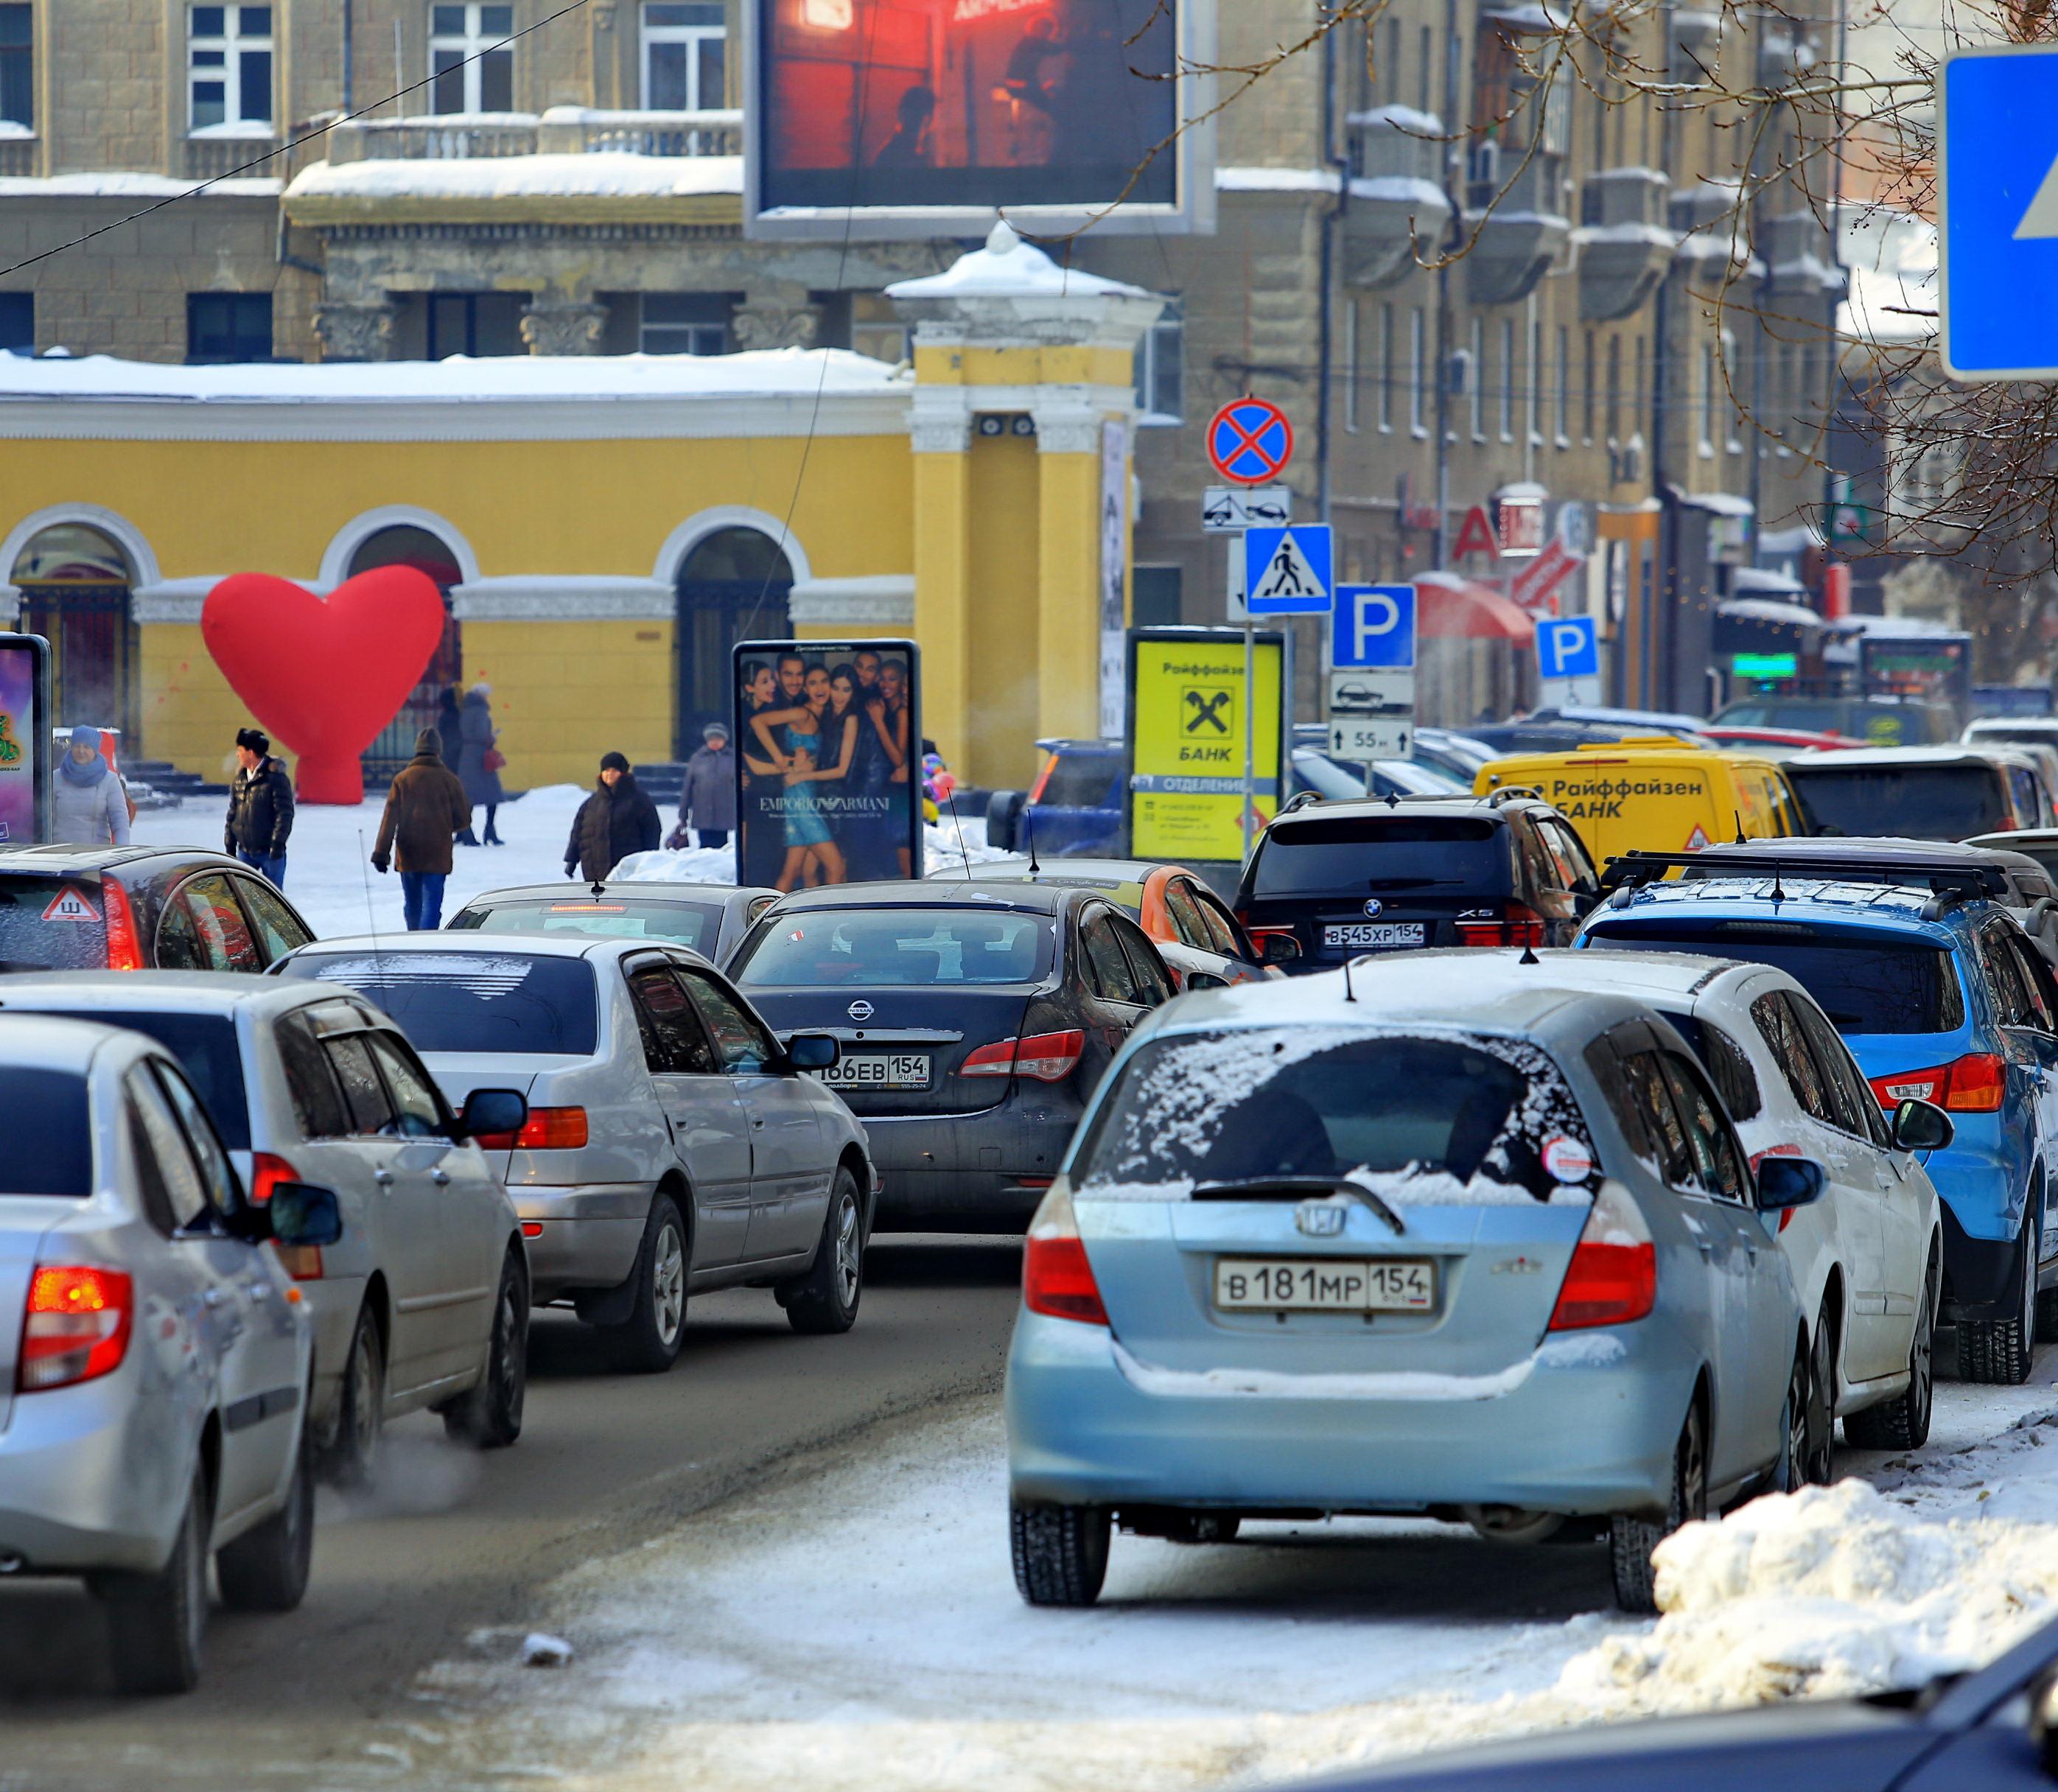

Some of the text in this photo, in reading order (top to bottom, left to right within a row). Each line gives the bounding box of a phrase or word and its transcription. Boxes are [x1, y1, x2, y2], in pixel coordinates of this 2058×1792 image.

[1354, 594, 1399, 660] P
[1553, 625, 1586, 672] P
[1163, 661, 1245, 677] Райффайзе
[1354, 732, 1376, 747] 55
[1180, 747, 1232, 762] БАНК
[1553, 778, 1702, 799] Райффайзен
[760, 797, 889, 811] EMPORIO ARMANI
[1556, 801, 1623, 819] БАНК
[61, 903, 80, 913] Ш
[1396, 925, 1421, 937] 154
[819, 1057, 923, 1081] 166ЕВ 154
[1229, 1267, 1423, 1302] В181МР 154
